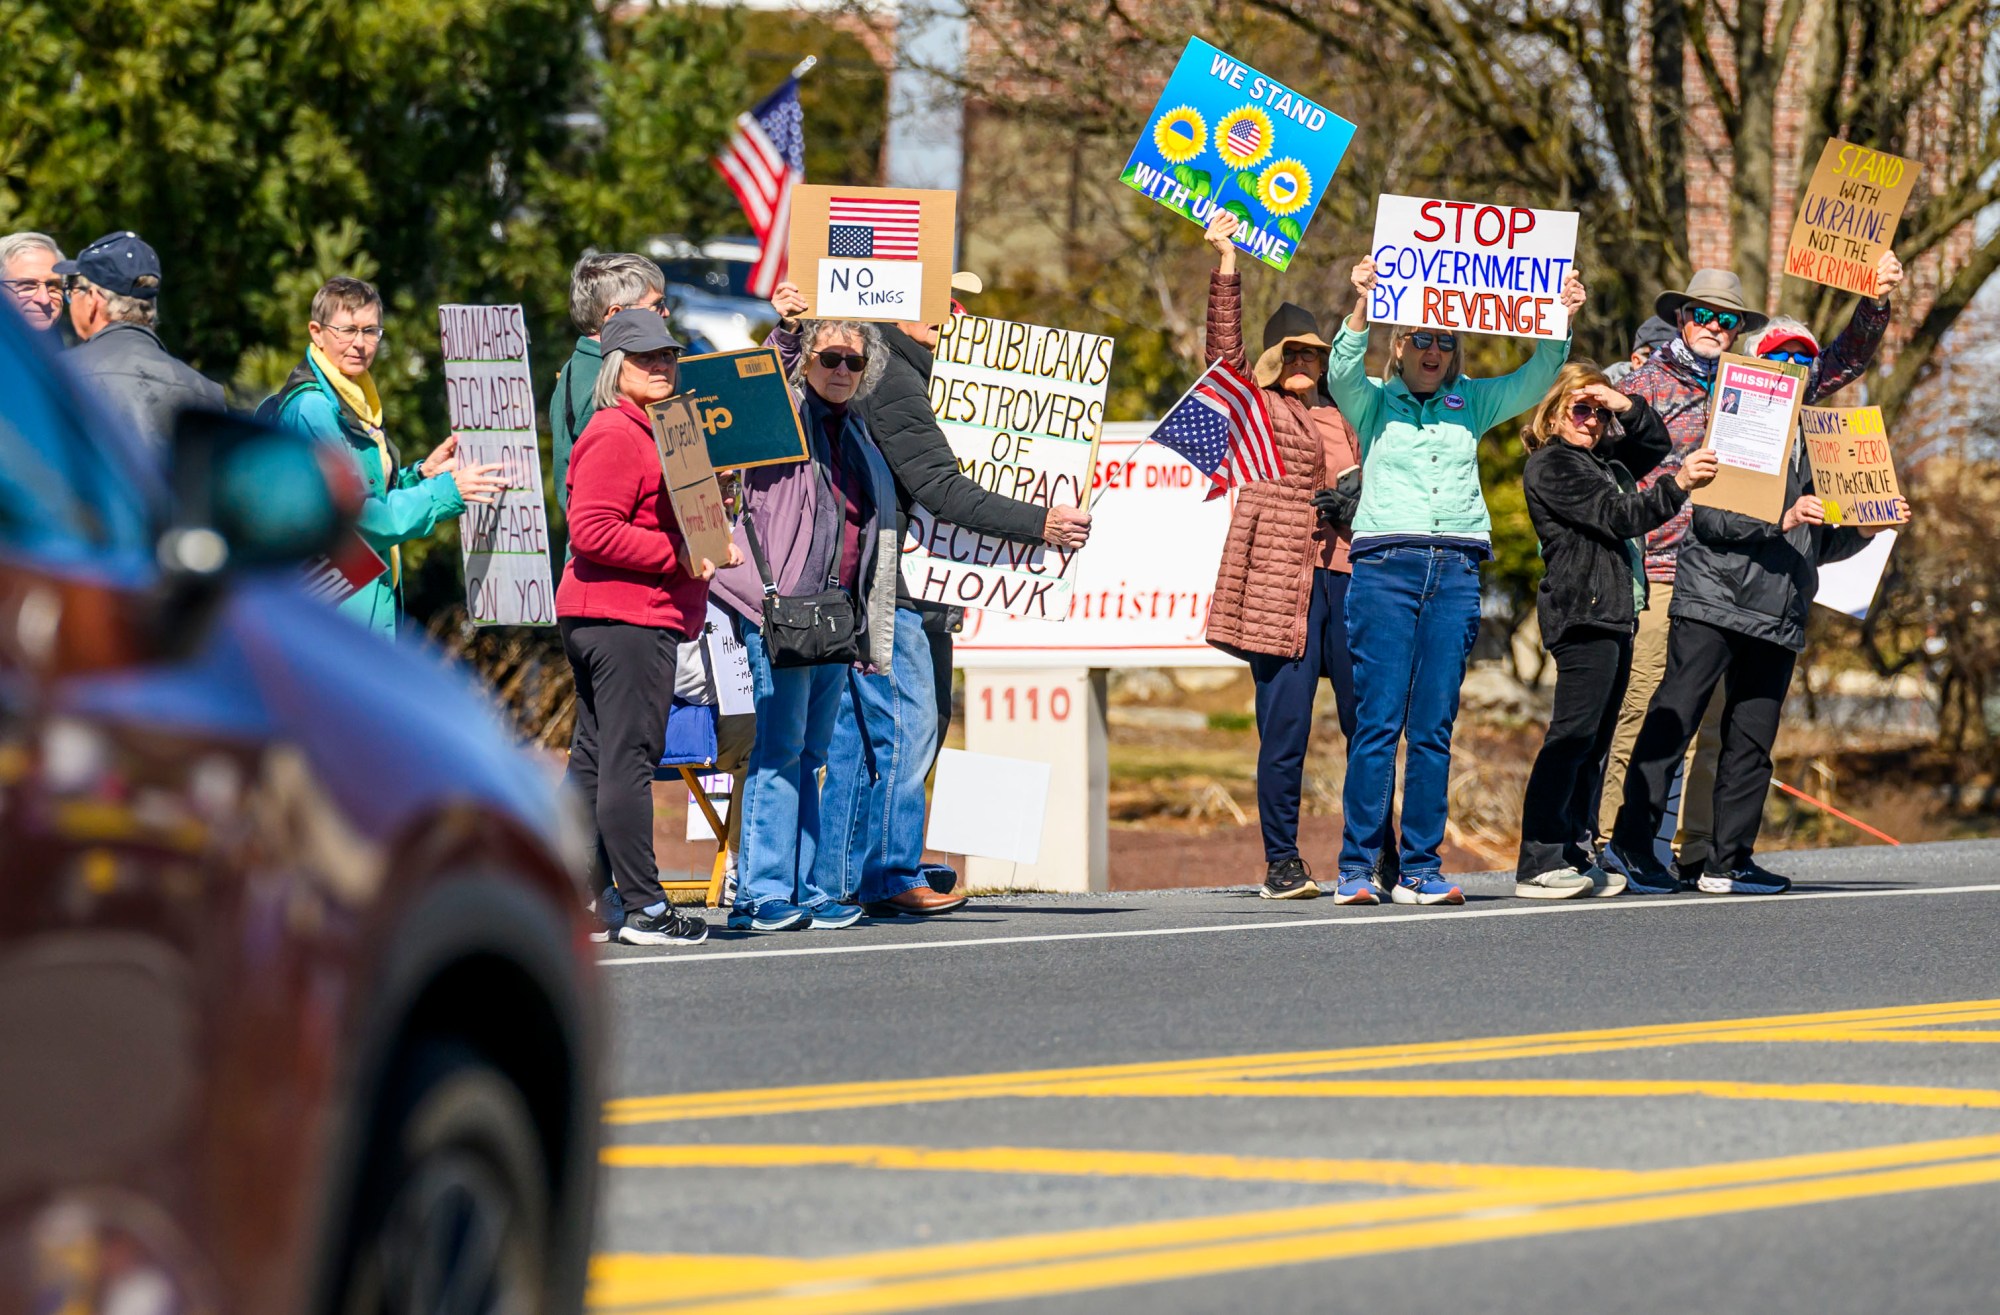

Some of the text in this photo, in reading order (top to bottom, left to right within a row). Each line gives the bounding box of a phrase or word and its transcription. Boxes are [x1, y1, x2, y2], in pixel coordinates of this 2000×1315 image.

[1209, 53, 1327, 132] WE STAND
[1832, 145, 1905, 188] STAND
[1132, 161, 1289, 264] WITH UKAINE
[1839, 180, 1882, 206] WITH
[1413, 200, 1536, 250] STOP
[1805, 193, 1892, 244] UKRAINE
[1374, 245, 1572, 294] GOVERNMENT
[1808, 230, 1871, 263] NOT THE
[830, 267, 874, 293] NO
[1789, 246, 1880, 296] WAR CRIMINAL
[858, 290, 905, 306] KINGS
[1372, 283, 1554, 336] BY REVENGE
[447, 376, 531, 431] DECLARED
[1731, 371, 1789, 393] MISSING
[697, 406, 733, 436] ch
[931, 375, 1103, 442] DESTROYERS
[1801, 408, 1842, 435] ZELENSKY
[1846, 409, 1883, 435] HERO
[656, 413, 700, 470] Impeach
[991, 432, 1033, 463] OF
[1809, 440, 1840, 464] TRUMP
[1854, 441, 1887, 465] ZERO
[500, 445, 534, 490] OUT
[957, 457, 1085, 509] MOCRACY
[1092, 461, 1136, 488] ser
[1146, 465, 1193, 488] DMD
[1816, 469, 1832, 495] REP
[460, 504, 546, 552] WARFARE
[1842, 503, 1856, 521] WITH
[1854, 497, 1903, 524] UKRAINE
[902, 517, 1079, 580] DECENCY
[469, 577, 553, 624] ON YOU
[922, 566, 1054, 618] HONK
[1069, 581, 1212, 641] ntistry
[722, 635, 744, 654] HAN
[980, 687, 1071, 721] 1110
